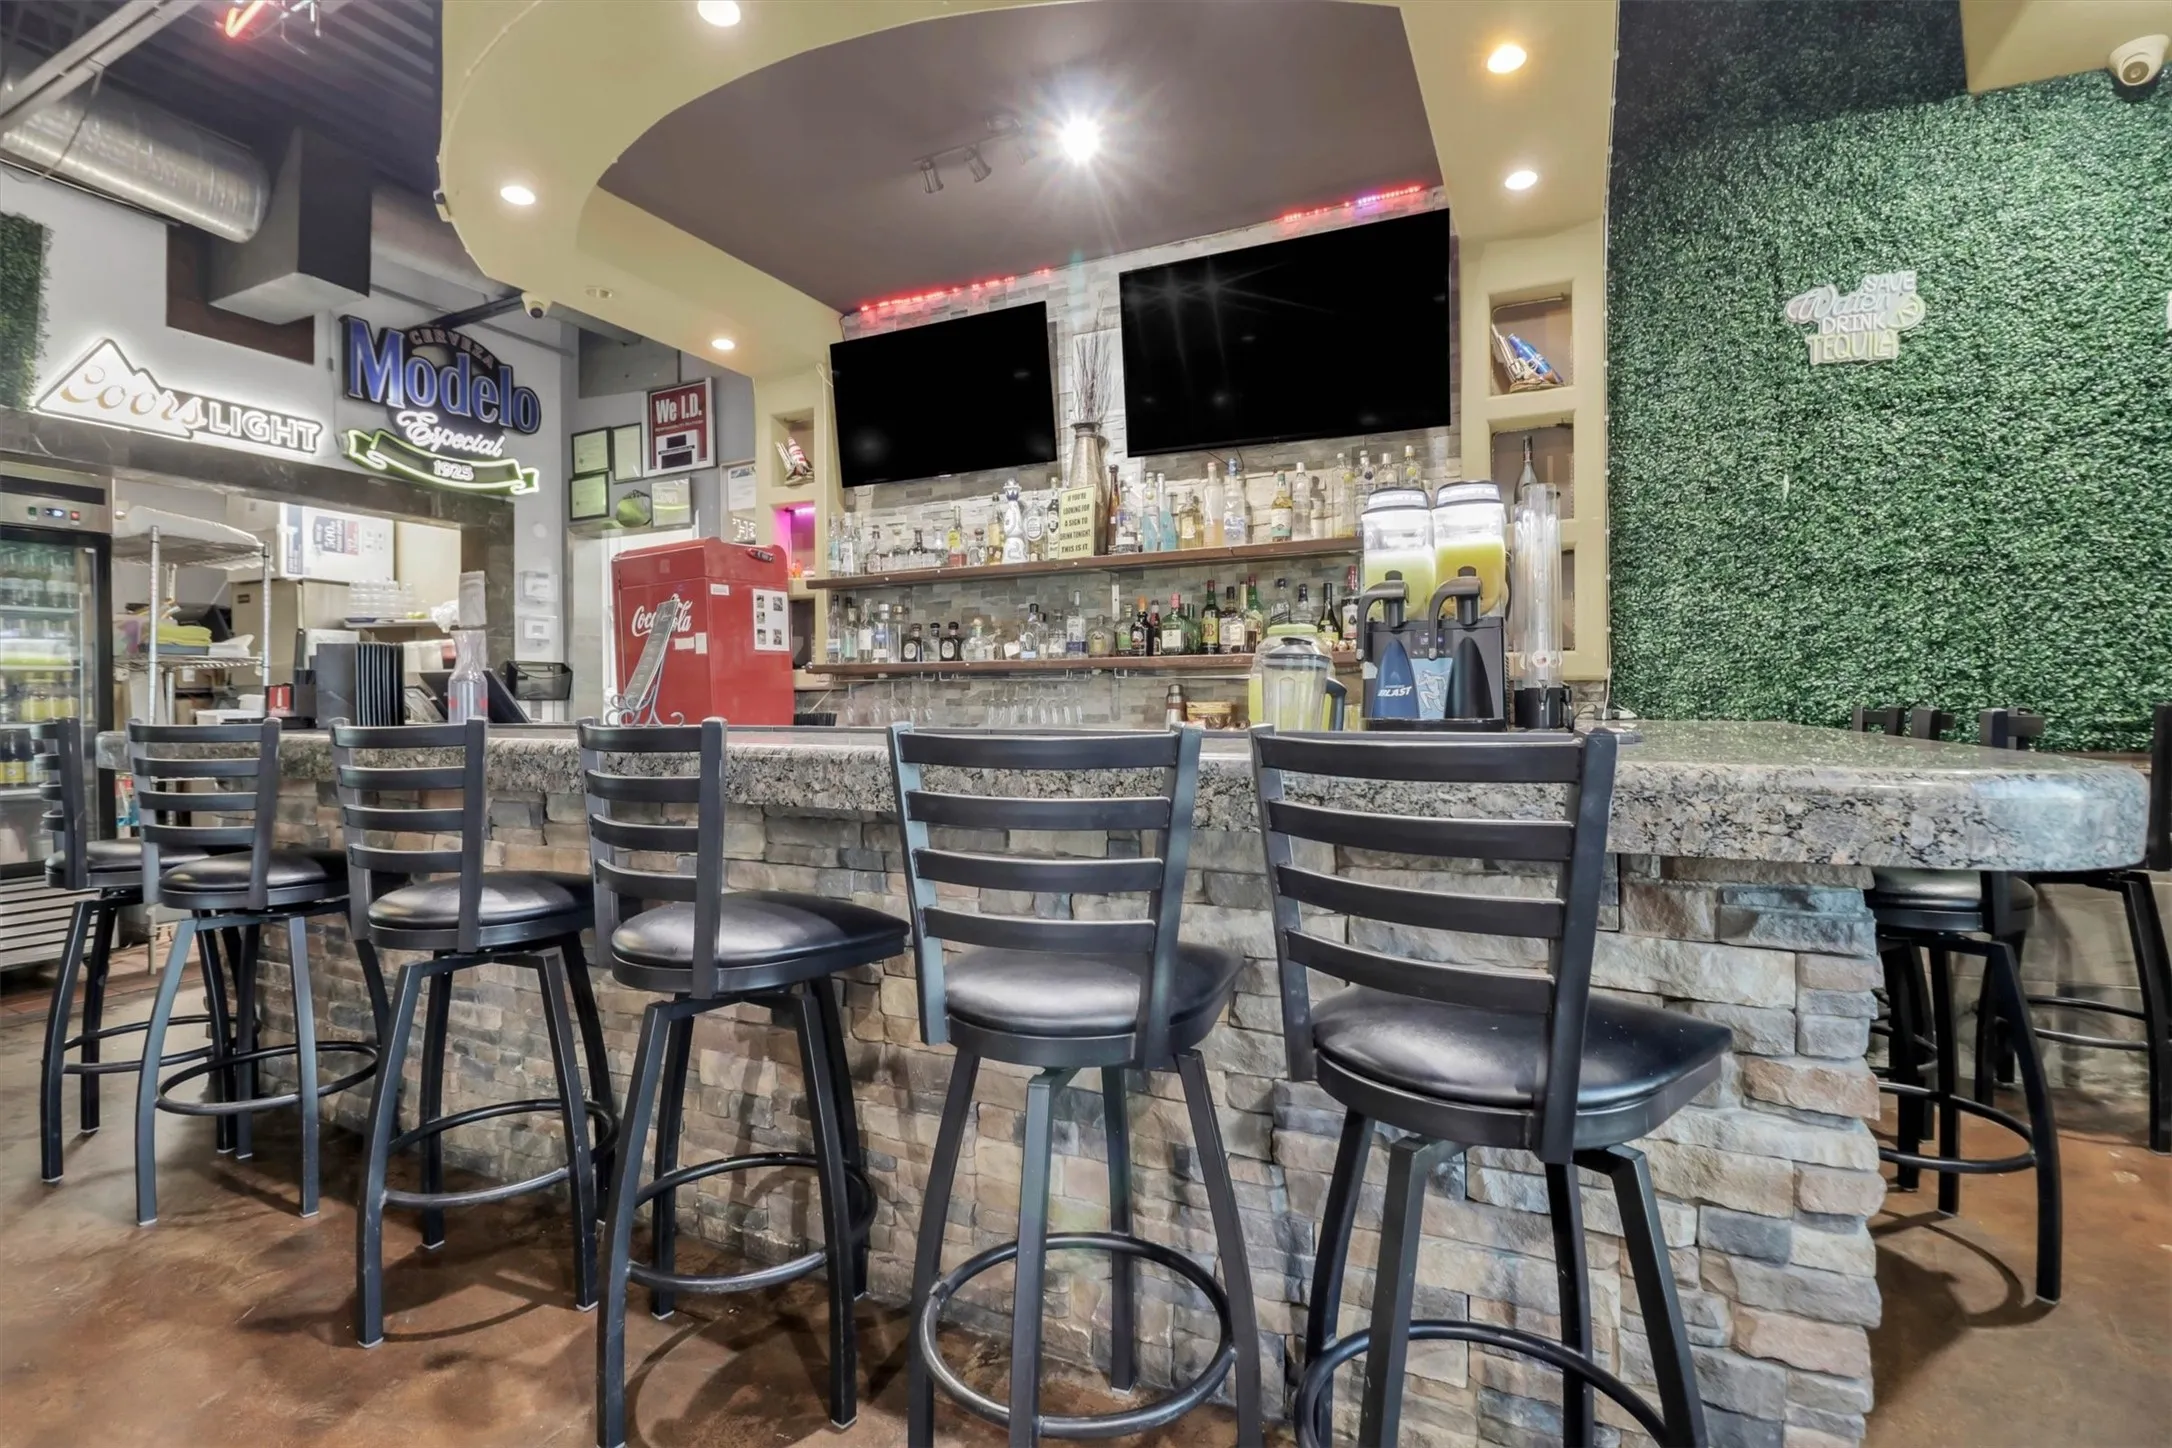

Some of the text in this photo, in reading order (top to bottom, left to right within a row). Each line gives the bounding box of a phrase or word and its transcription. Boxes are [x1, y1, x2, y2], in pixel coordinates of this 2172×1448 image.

[1863, 270, 1915, 293] SAVE
[1822, 311, 1886, 335] DRINK
[408, 328, 495, 370] CERVEZA
[1806, 329, 1898, 364] TEQUILA
[347, 315, 542, 435] Modelo
[59, 363, 322, 454] Coors LIGHT
[655, 392, 703, 424] We I.D.
[396, 410, 506, 458] Especial
[432, 459, 475, 481] 1925
[1069, 518, 1080, 527] SIGN
[1061, 545, 1075, 554] THIS
[1075, 544, 1082, 552] IS
[1377, 685, 1413, 697] BLAST
